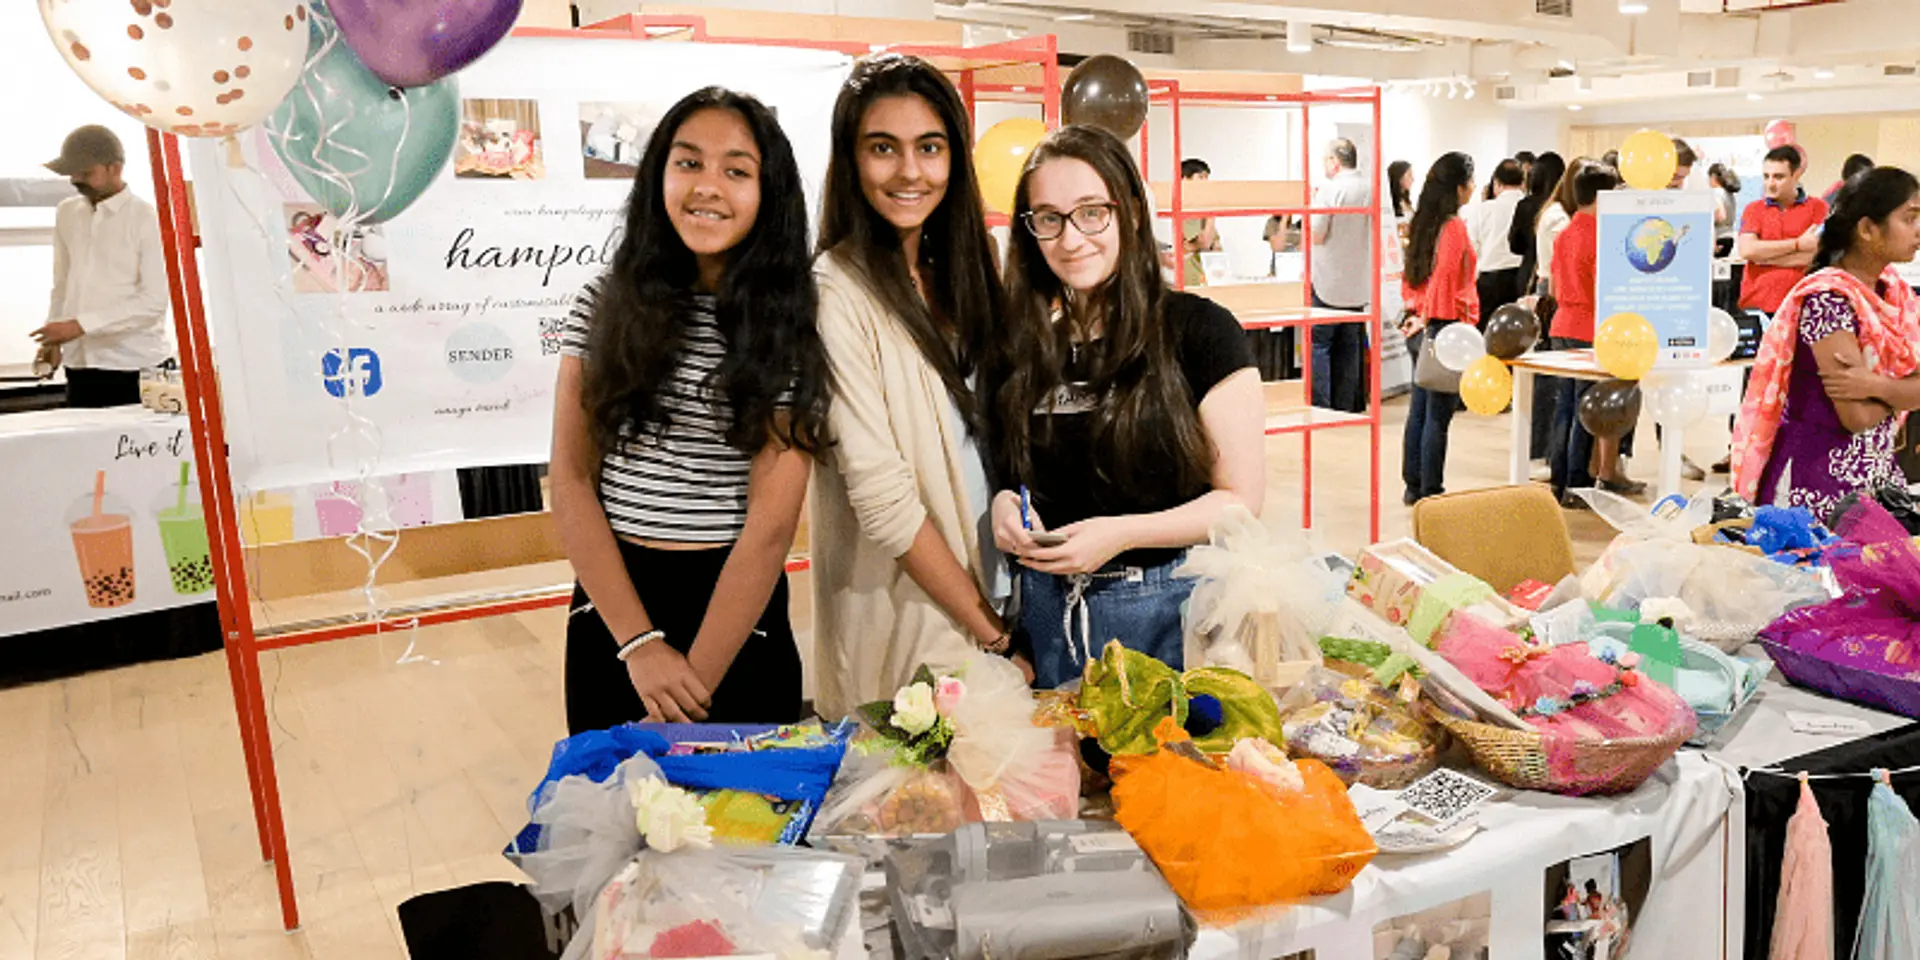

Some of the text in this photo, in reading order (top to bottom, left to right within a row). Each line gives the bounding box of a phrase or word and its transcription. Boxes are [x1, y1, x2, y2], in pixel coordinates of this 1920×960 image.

[444, 226, 625, 287] hampol
[447, 348, 514, 364] SENDER
[115, 429, 184, 460] Live it
